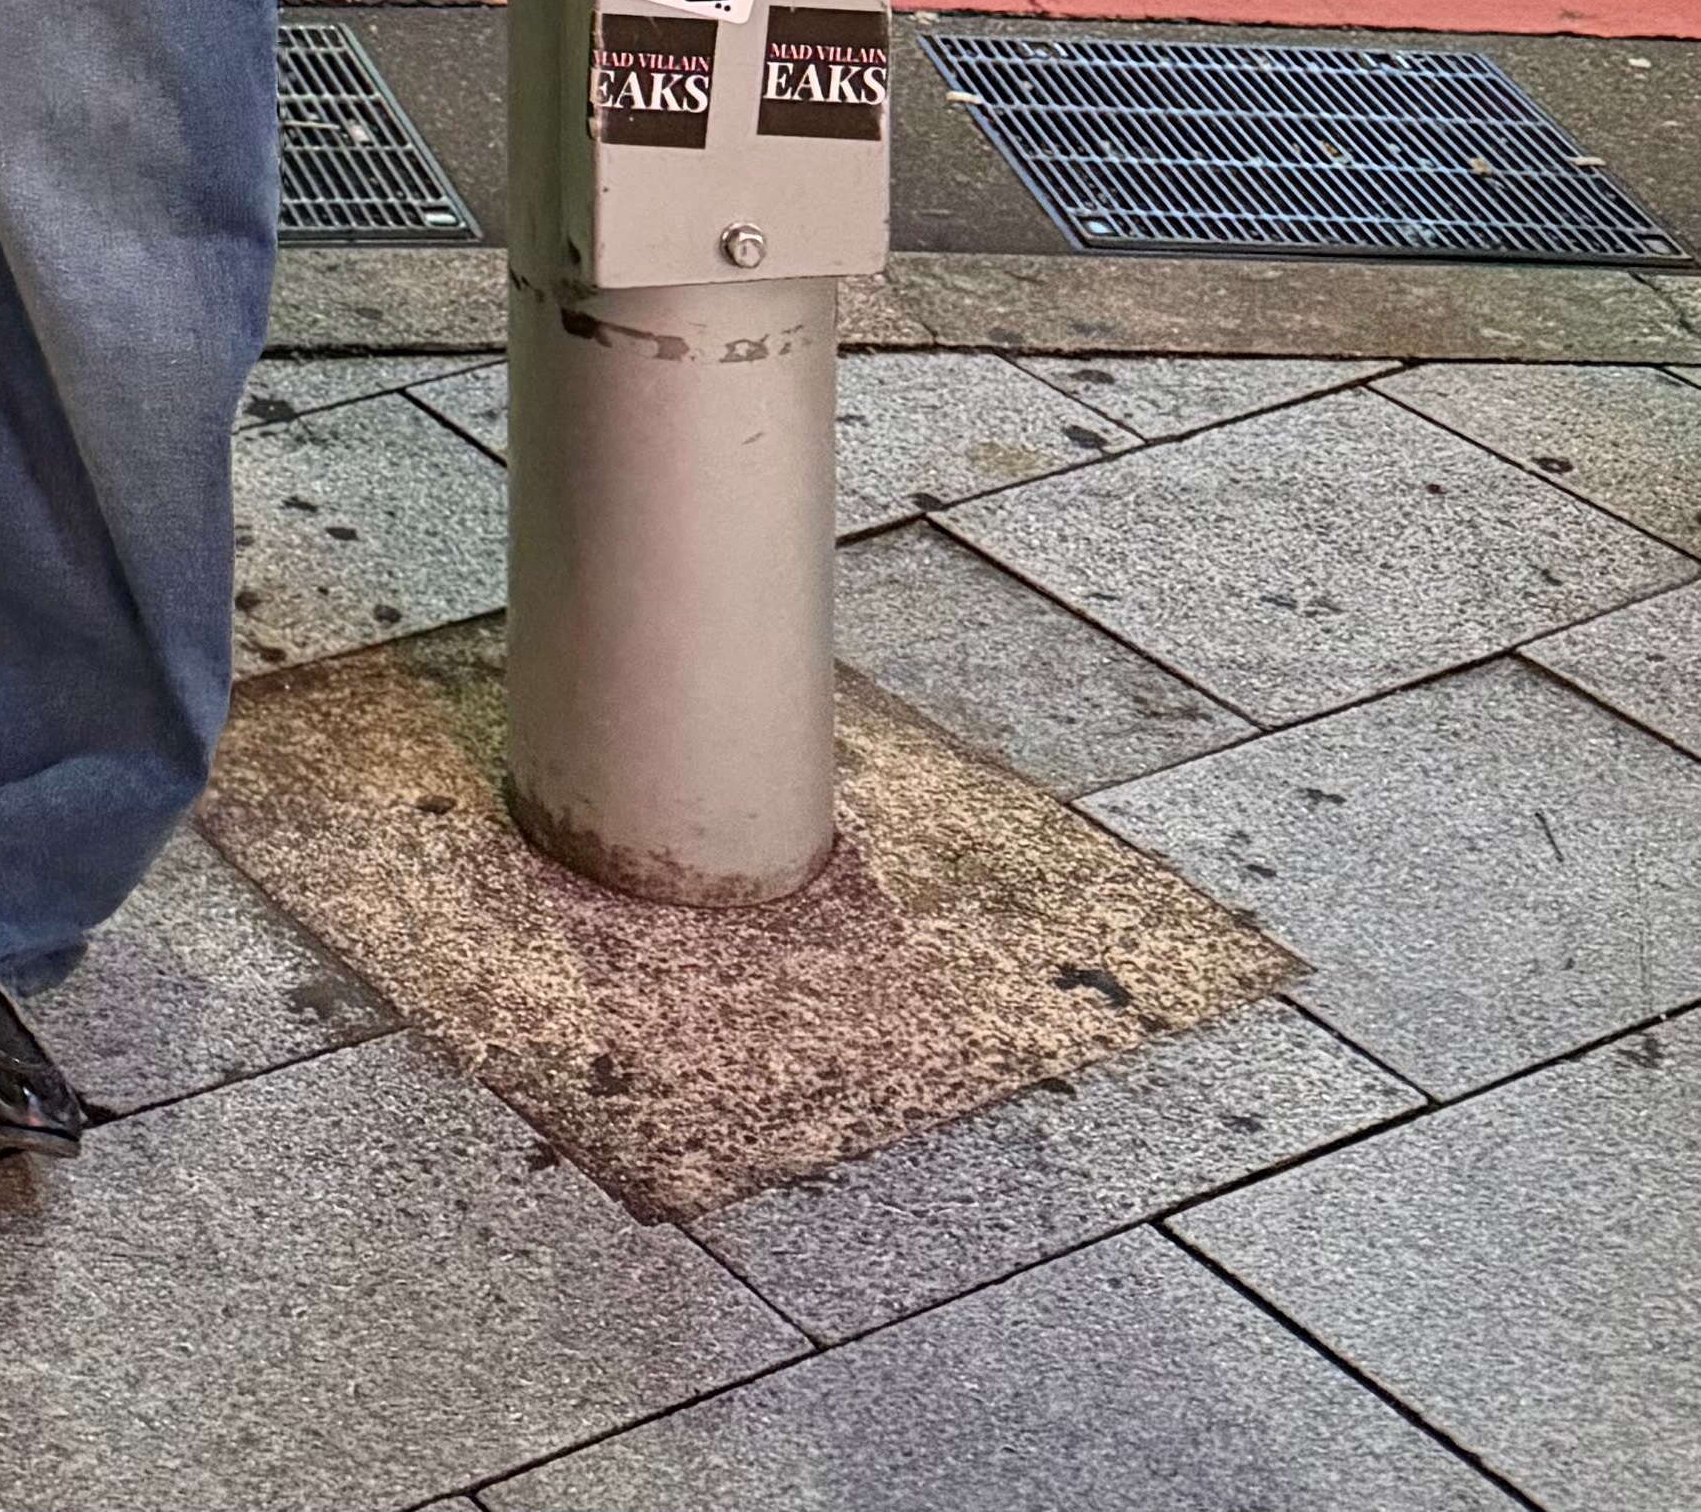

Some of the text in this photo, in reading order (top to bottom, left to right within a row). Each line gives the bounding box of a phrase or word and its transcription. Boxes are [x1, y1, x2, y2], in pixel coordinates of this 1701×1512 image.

[593, 49, 710, 73] MAD VILLAIN
[770, 42, 887, 64] MAD VILLAIN
[593, 69, 710, 114] EAKS
[762, 61, 888, 106] EAKS
